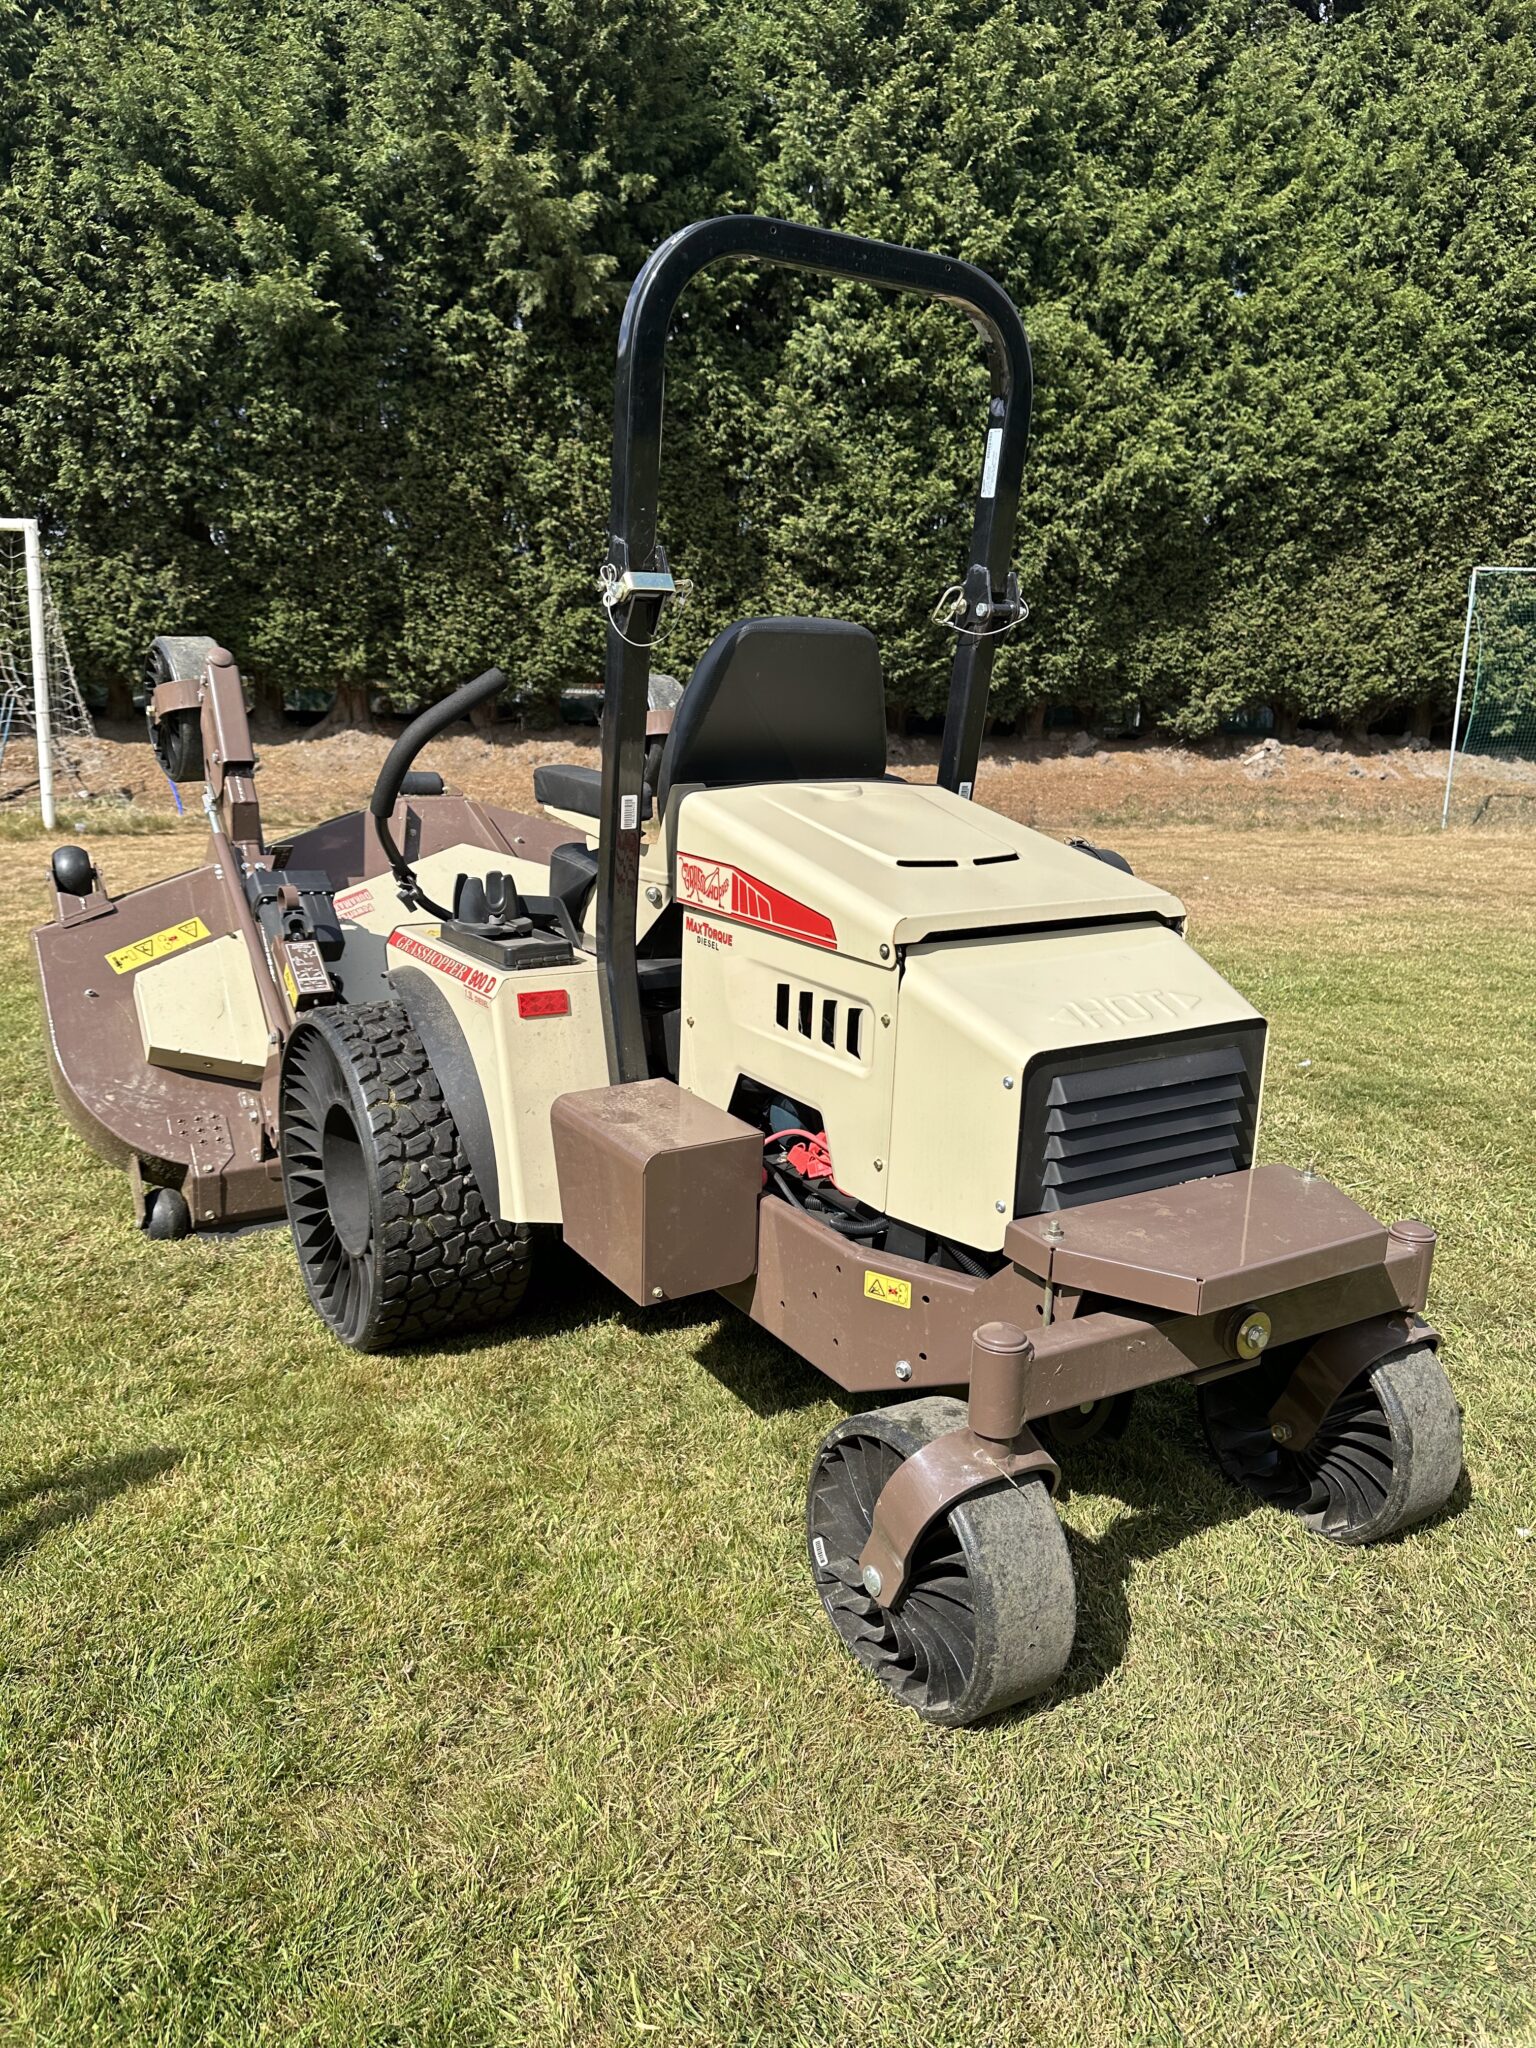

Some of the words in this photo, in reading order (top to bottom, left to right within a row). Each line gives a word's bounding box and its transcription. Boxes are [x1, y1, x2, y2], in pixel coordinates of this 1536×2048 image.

[696, 935, 720, 951] DIESEL
[396, 936, 468, 979] GRASSHOPPER
[468, 969, 489, 991] 900
[484, 976, 497, 994] D
[1067, 989, 1178, 1029] HOT
